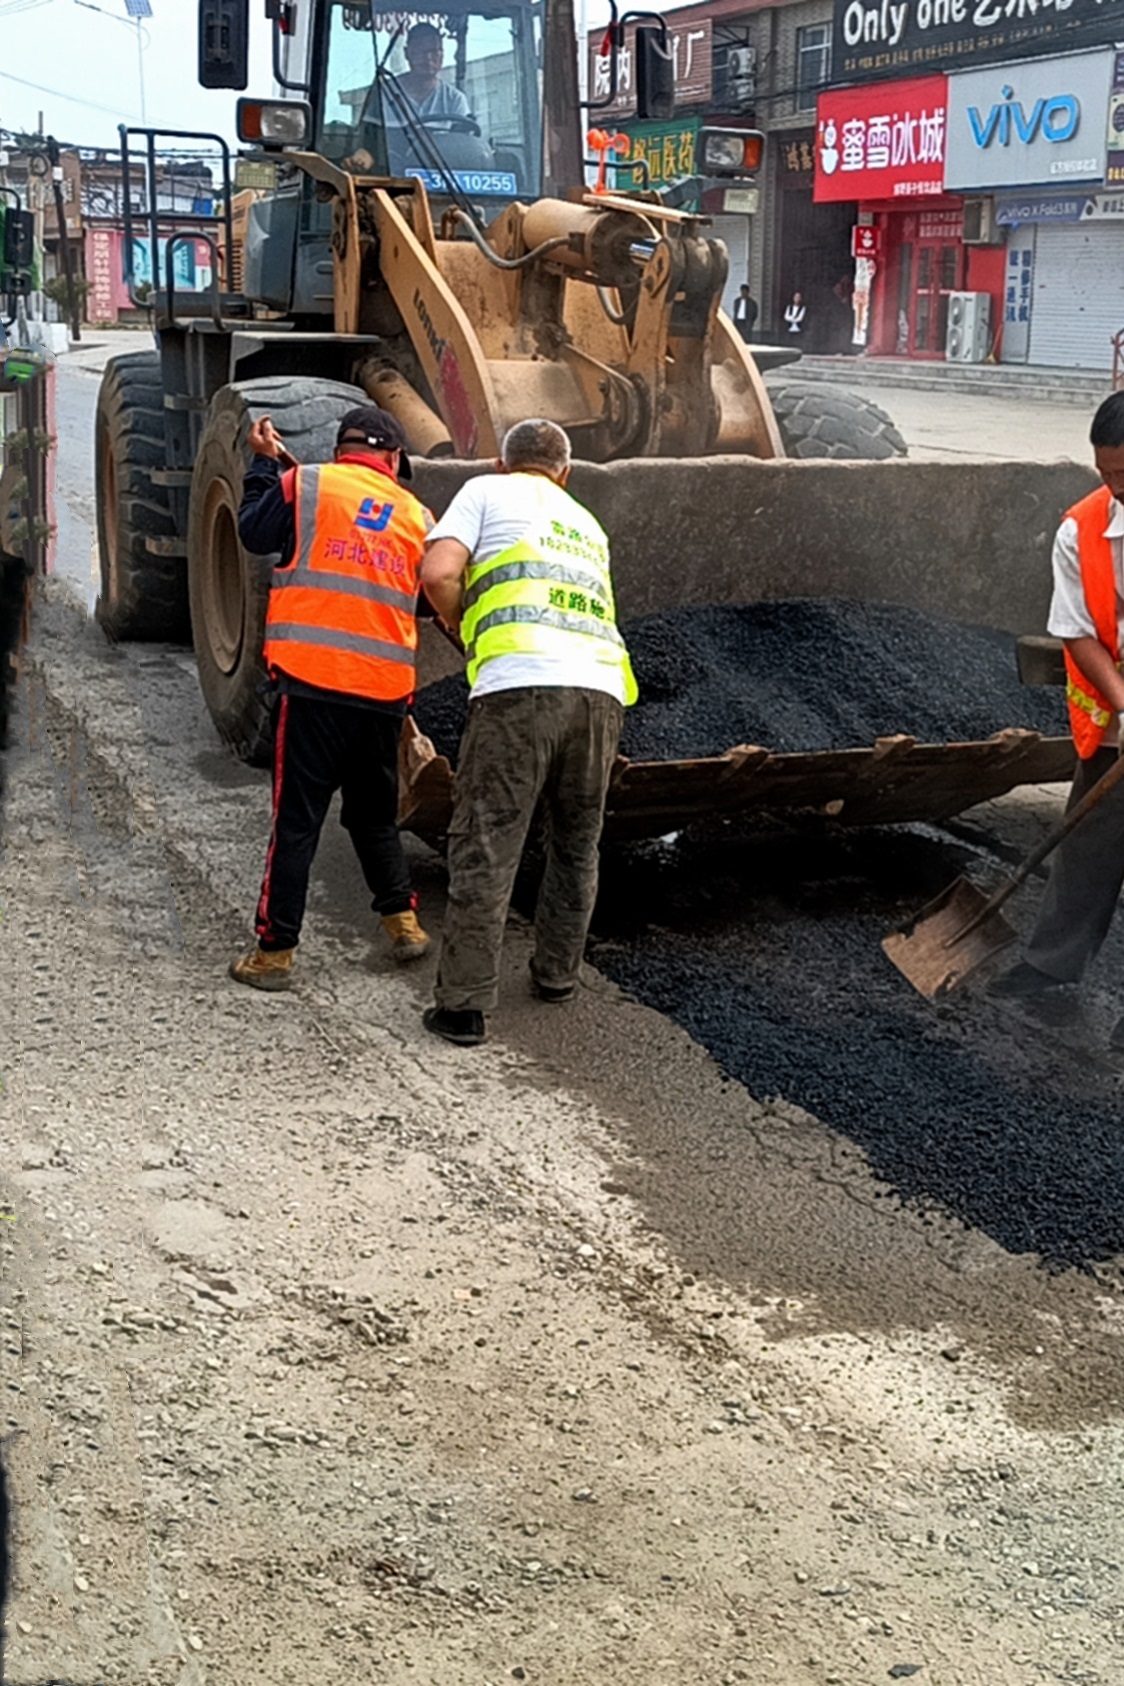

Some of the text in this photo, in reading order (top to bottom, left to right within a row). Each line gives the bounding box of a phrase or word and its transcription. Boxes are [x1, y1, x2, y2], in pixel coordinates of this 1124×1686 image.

[843, 0, 908, 46] Only
[917, 0, 967, 29] one
[966, 84, 1082, 149] vivo
[841, 107, 945, 171] 蜜雪冰城
[462, 175, 512, 191] 10255
[324, 537, 405, 577] 河北建设
[548, 586, 614, 622] 道路施
